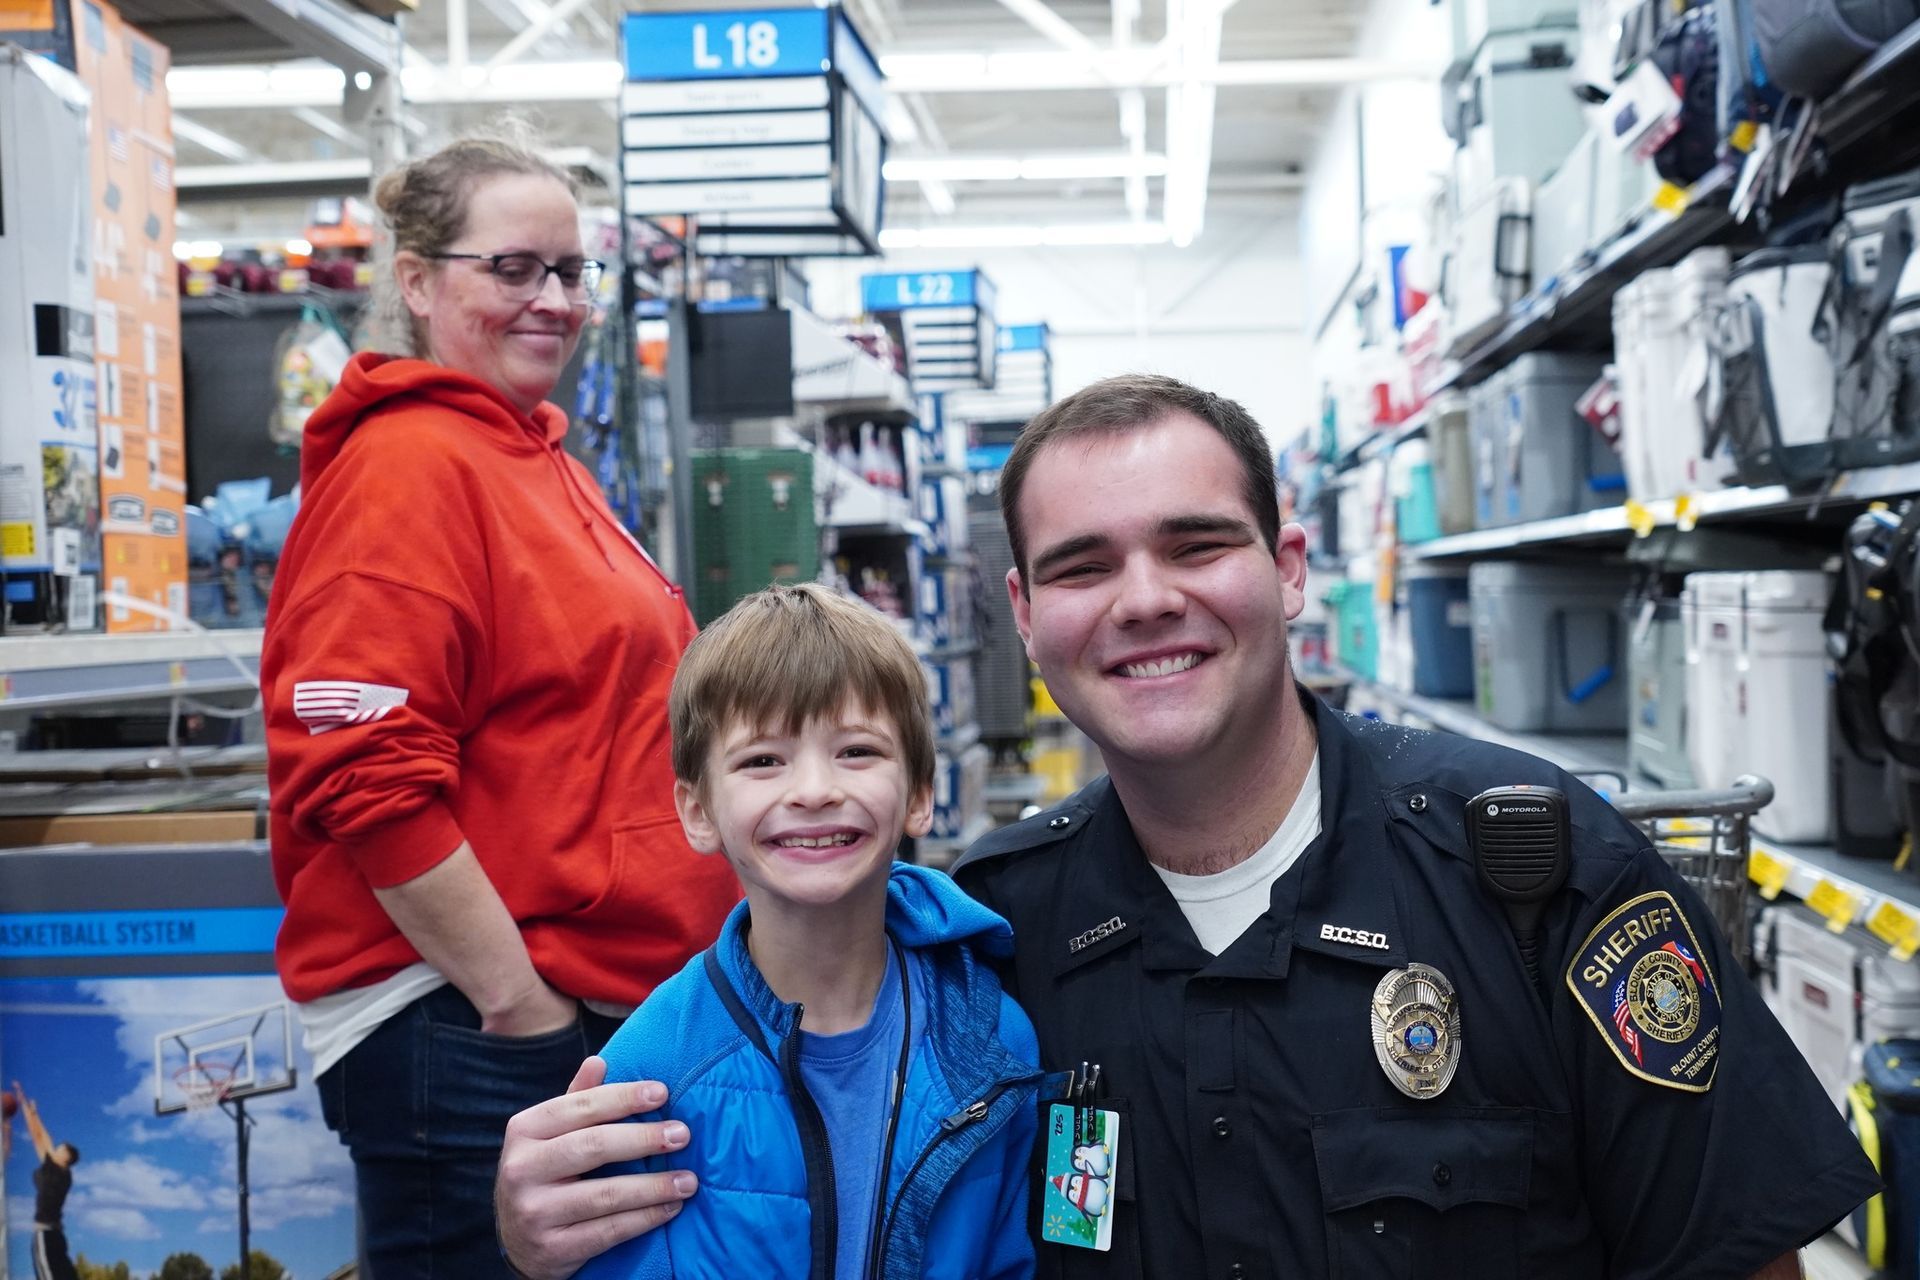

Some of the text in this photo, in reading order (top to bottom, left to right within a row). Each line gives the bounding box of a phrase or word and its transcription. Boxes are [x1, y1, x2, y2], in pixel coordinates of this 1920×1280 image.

[693, 20, 779, 69] L 18
[897, 273, 954, 304] L 22
[116, 920, 195, 944] SYSTEM
[1069, 916, 1126, 953] B.C.S.O.
[1320, 924, 1389, 950] B.C.S.O.
[1583, 908, 1673, 988] SHERIFF
[1630, 953, 1682, 1002] BLOUNT COUNTY
[1647, 972, 1676, 997] STATE OF
[1387, 1004, 1419, 1033] BLOUNT
[1646, 988, 1699, 1040] SHERIFF'S OFFICE
[1670, 1025, 1720, 1076] BLOUNT COUNTY
[1685, 1043, 1718, 1079] TENNESSEE
